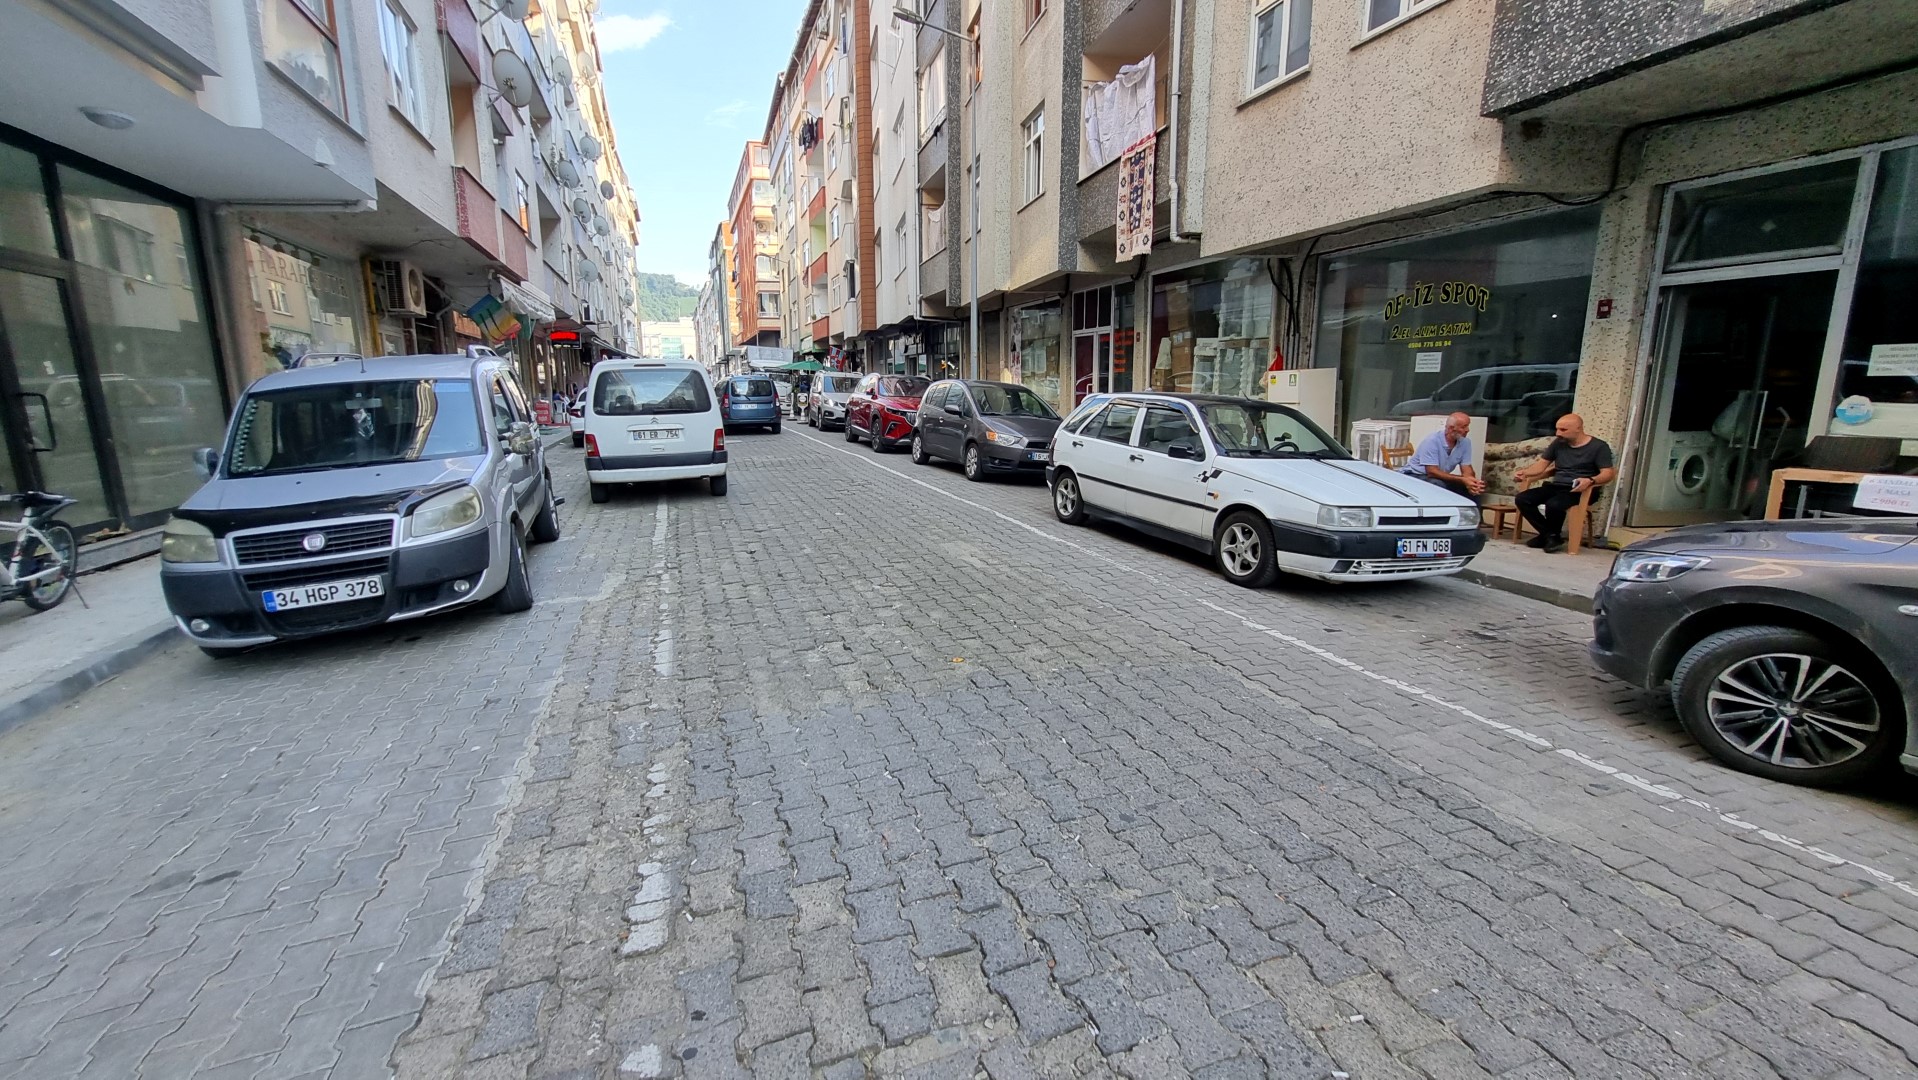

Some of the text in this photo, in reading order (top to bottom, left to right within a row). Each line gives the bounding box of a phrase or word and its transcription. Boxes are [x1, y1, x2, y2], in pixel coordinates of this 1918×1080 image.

[1440, 282, 1489, 312] SPOT
[1413, 325, 1437, 338] ALIM
[1440, 322, 1472, 337] SATIM
[638, 431, 646, 439] 61
[665, 430, 678, 438] 754
[1402, 541, 1450, 552] 61 FN 068
[276, 580, 379, 607] 34 HGP 378
